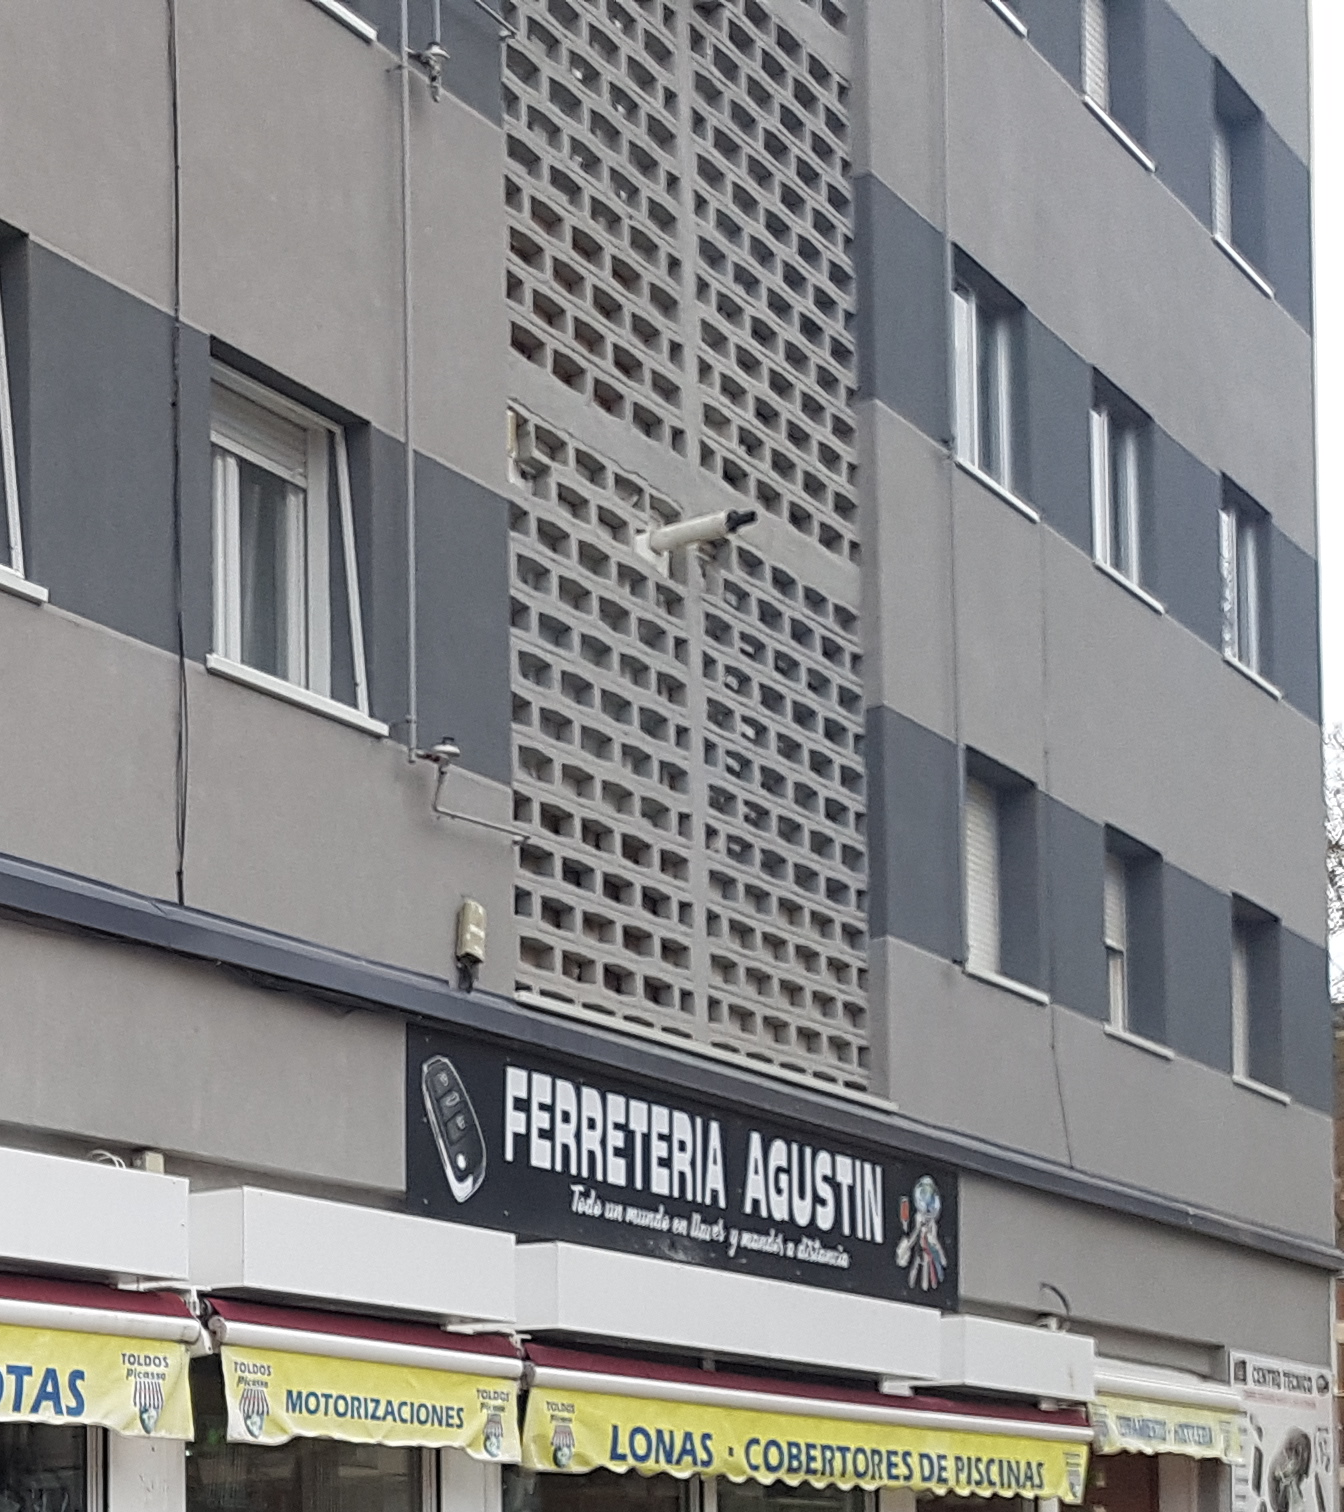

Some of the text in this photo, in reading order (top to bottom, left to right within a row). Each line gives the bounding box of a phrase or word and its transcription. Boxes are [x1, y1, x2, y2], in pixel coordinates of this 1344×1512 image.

[503, 1065, 885, 1245] FERRETERIA AGUSTIN
[571, 1184, 602, 1215] Todo
[604, 1201, 623, 1222] un
[626, 1205, 670, 1231] mundo
[672, 1217, 688, 1236] en
[728, 1229, 740, 1257] y
[121, 1352, 169, 1368] TOLDOS
[234, 1361, 272, 1376] TOLDOS
[285, 1389, 465, 1429] MOTORIZACIONES
[609, 1424, 713, 1468] LONAS
[745, 1437, 912, 1484] COBERTORES
[919, 1451, 948, 1484] DE
[955, 1455, 1044, 1490] PISCINAS
